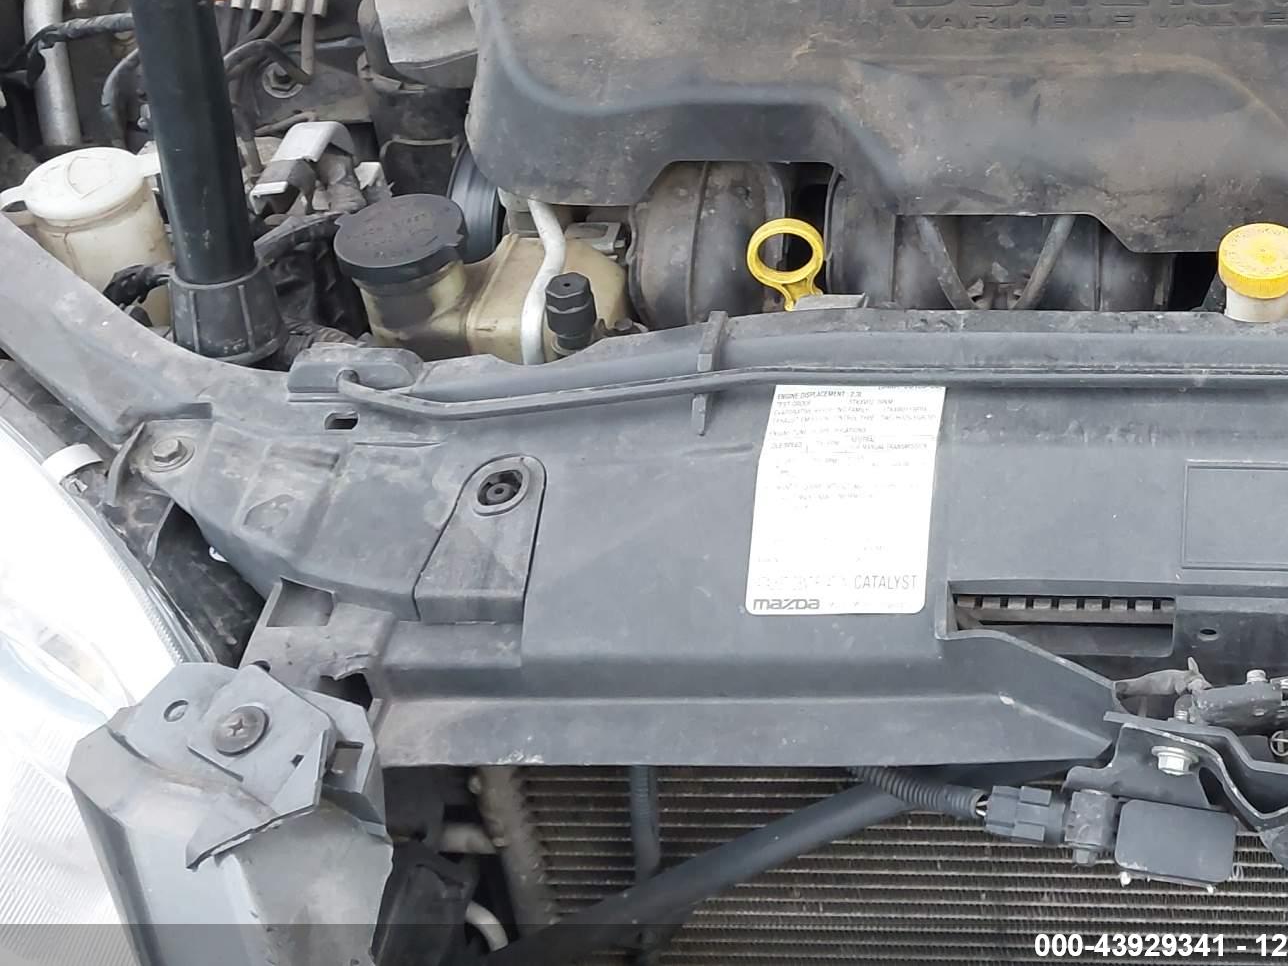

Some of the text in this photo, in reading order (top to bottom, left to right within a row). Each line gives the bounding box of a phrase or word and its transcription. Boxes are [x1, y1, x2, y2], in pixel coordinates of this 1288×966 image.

[908, 12, 1134, 31] VARIABLE
[1158, 11, 1286, 30] VALVE
[854, 574, 917, 589] CATALYST
[753, 598, 820, 610] mazda
